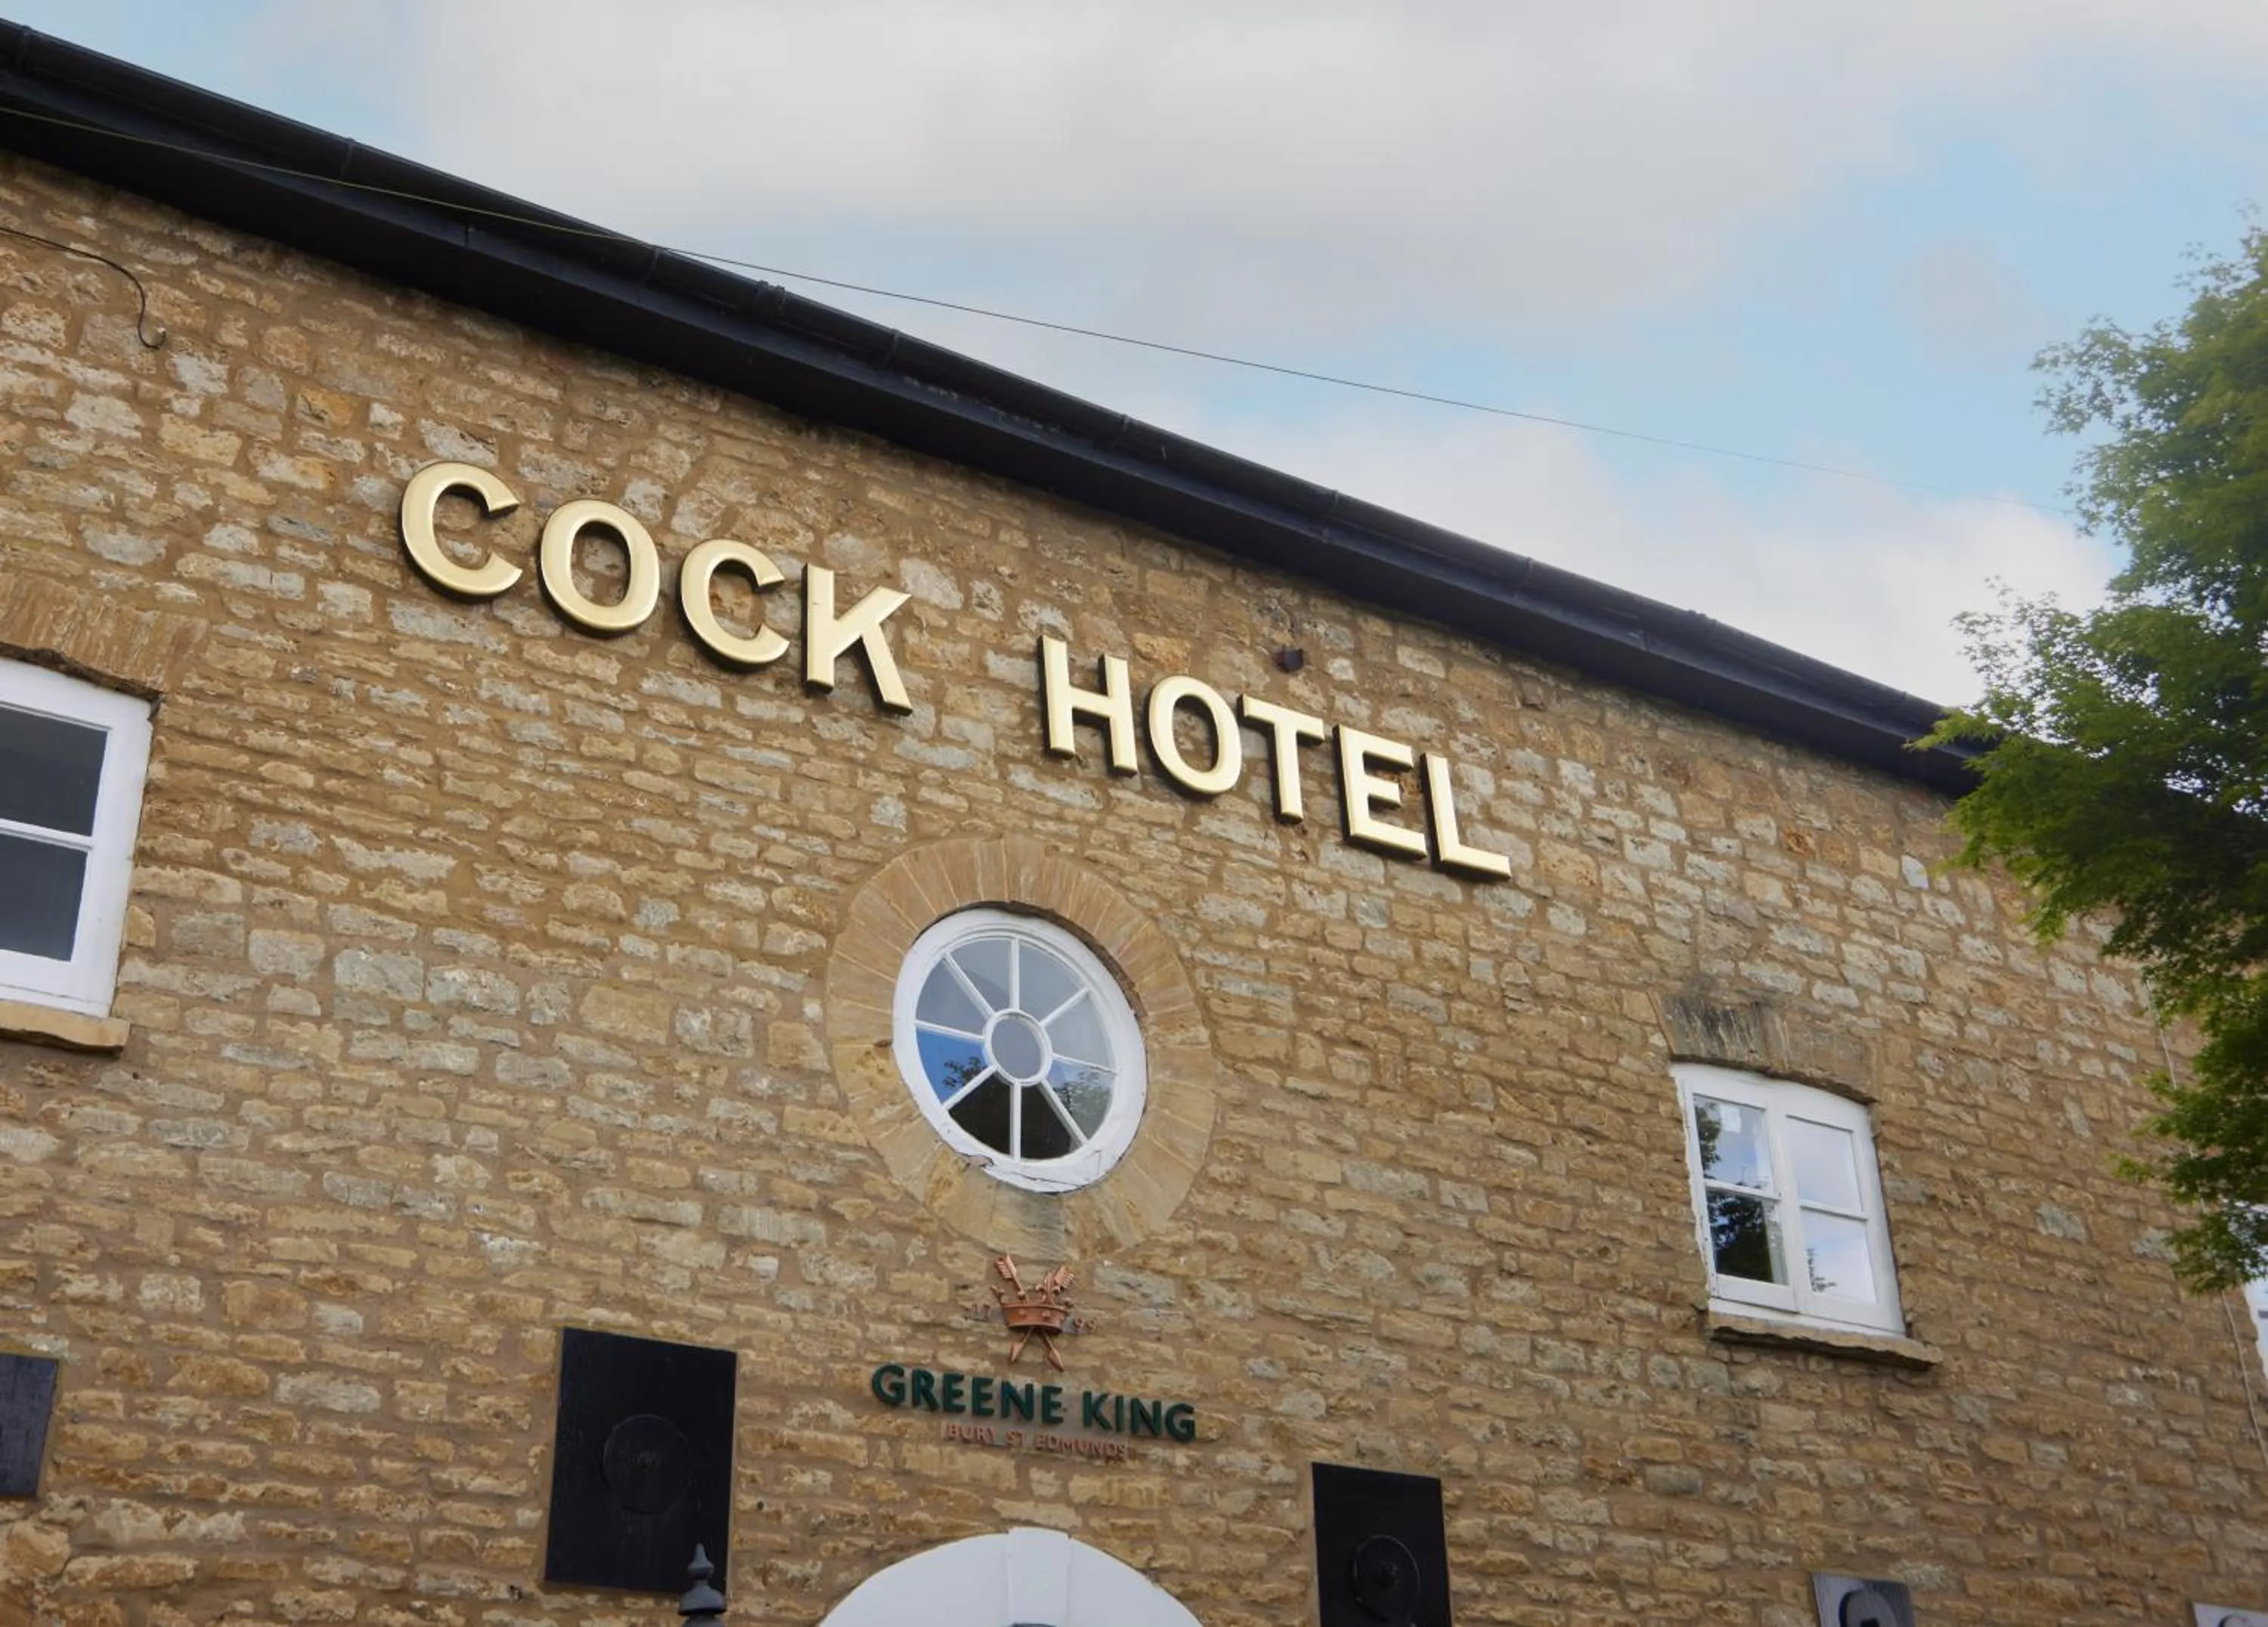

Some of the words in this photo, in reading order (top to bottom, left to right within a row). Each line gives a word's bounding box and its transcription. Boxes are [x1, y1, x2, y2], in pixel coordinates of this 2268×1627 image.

[401, 460, 912, 716] COCK
[1040, 634, 1511, 881] HOTEL
[872, 1364, 1064, 1424] GREENE
[1082, 1390, 1197, 1443] KING
[945, 1423, 997, 1445] BURY
[1035, 1431, 1127, 1461] EDMUNDS
